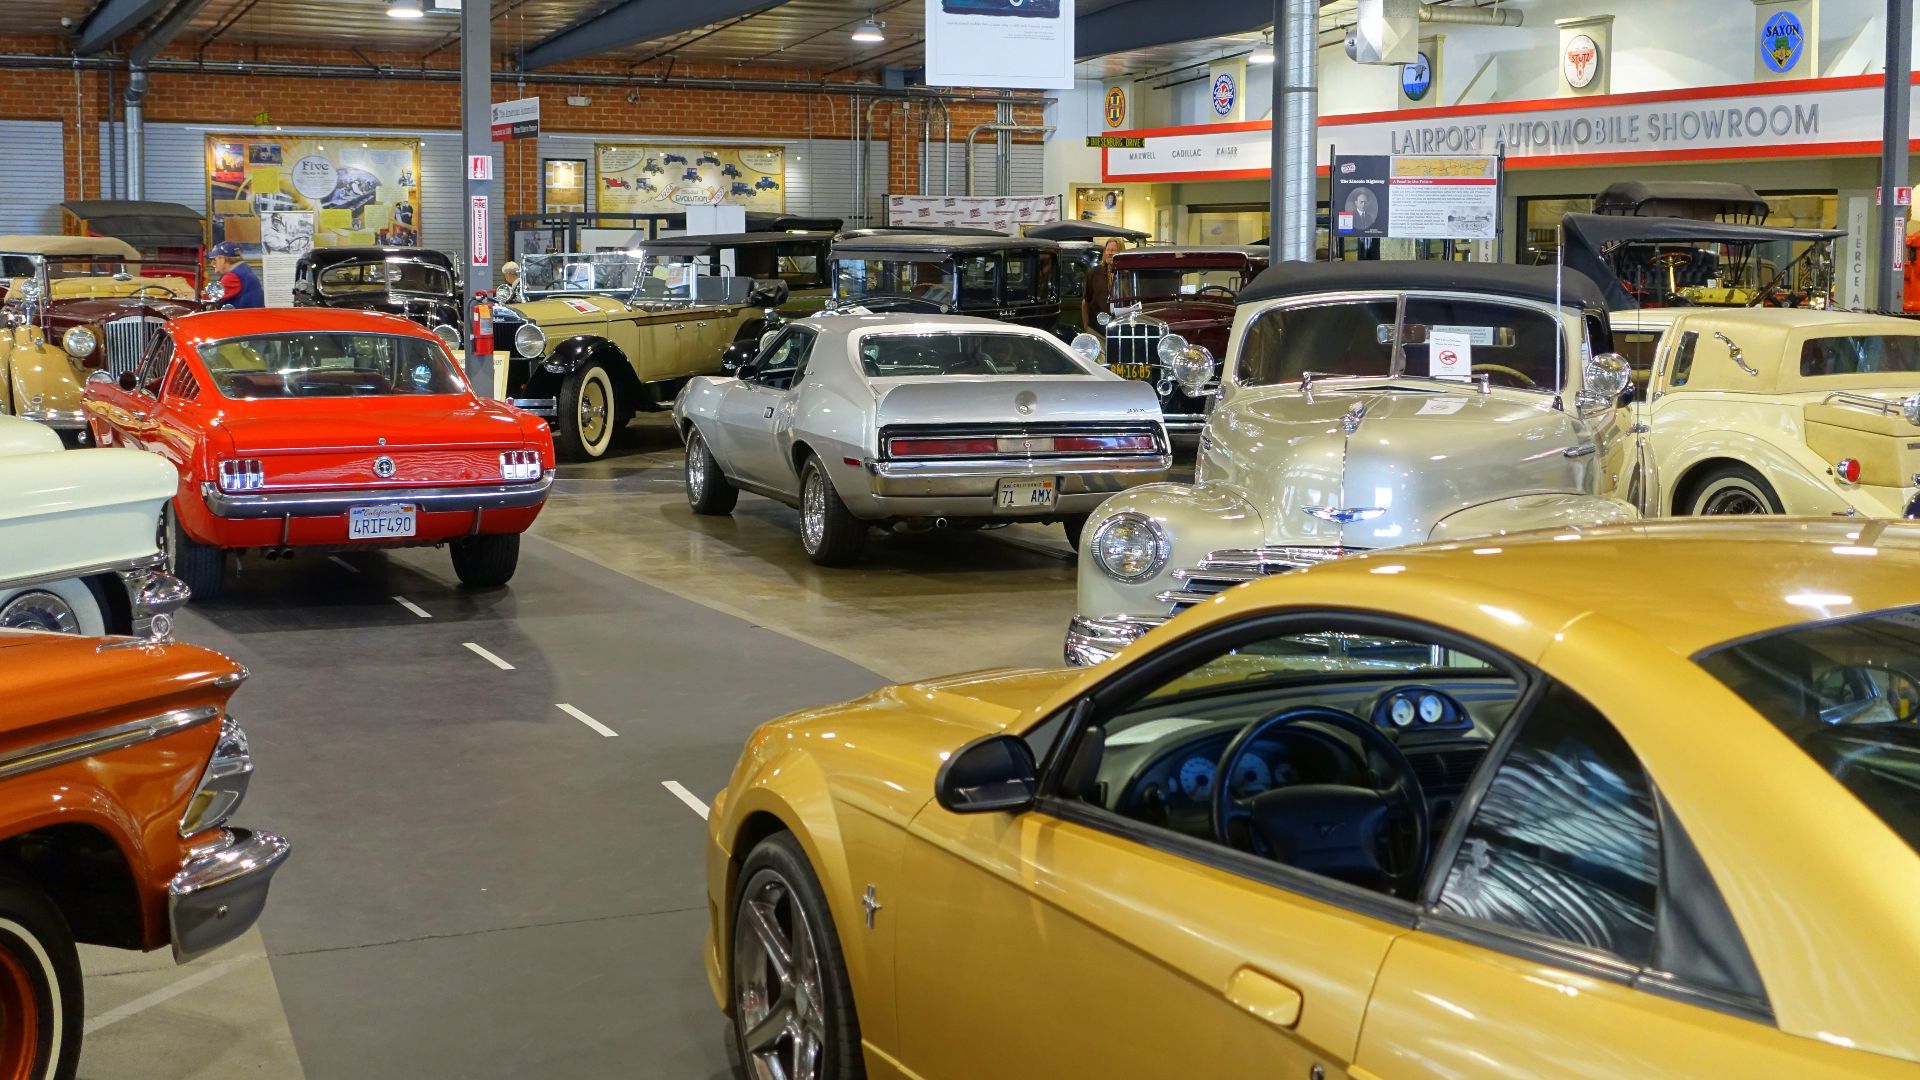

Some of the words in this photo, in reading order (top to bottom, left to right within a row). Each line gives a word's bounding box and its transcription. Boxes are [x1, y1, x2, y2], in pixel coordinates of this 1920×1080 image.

[1766, 24, 1799, 37] SAXON
[1571, 53, 1590, 62] STUTZ
[1391, 125, 1487, 154] LAIRPORT
[1496, 115, 1639, 149] AUTOMOBILE
[1648, 104, 1819, 142] SHOWROOM
[1126, 138, 1141, 147] DRIVE
[1129, 152, 1156, 160] MAXWELL
[1172, 149, 1201, 158] CADILLAC
[1216, 147, 1238, 156] KAISER
[302, 161, 329, 170] Five
[675, 194, 707, 202] EVOLUTION
[1853, 213, 1863, 287] PIERCE
[1002, 490, 1014, 504] 71
[1031, 489, 1052, 503] AMX
[363, 508, 402, 517] California
[353, 516, 411, 535] 4RIF490
